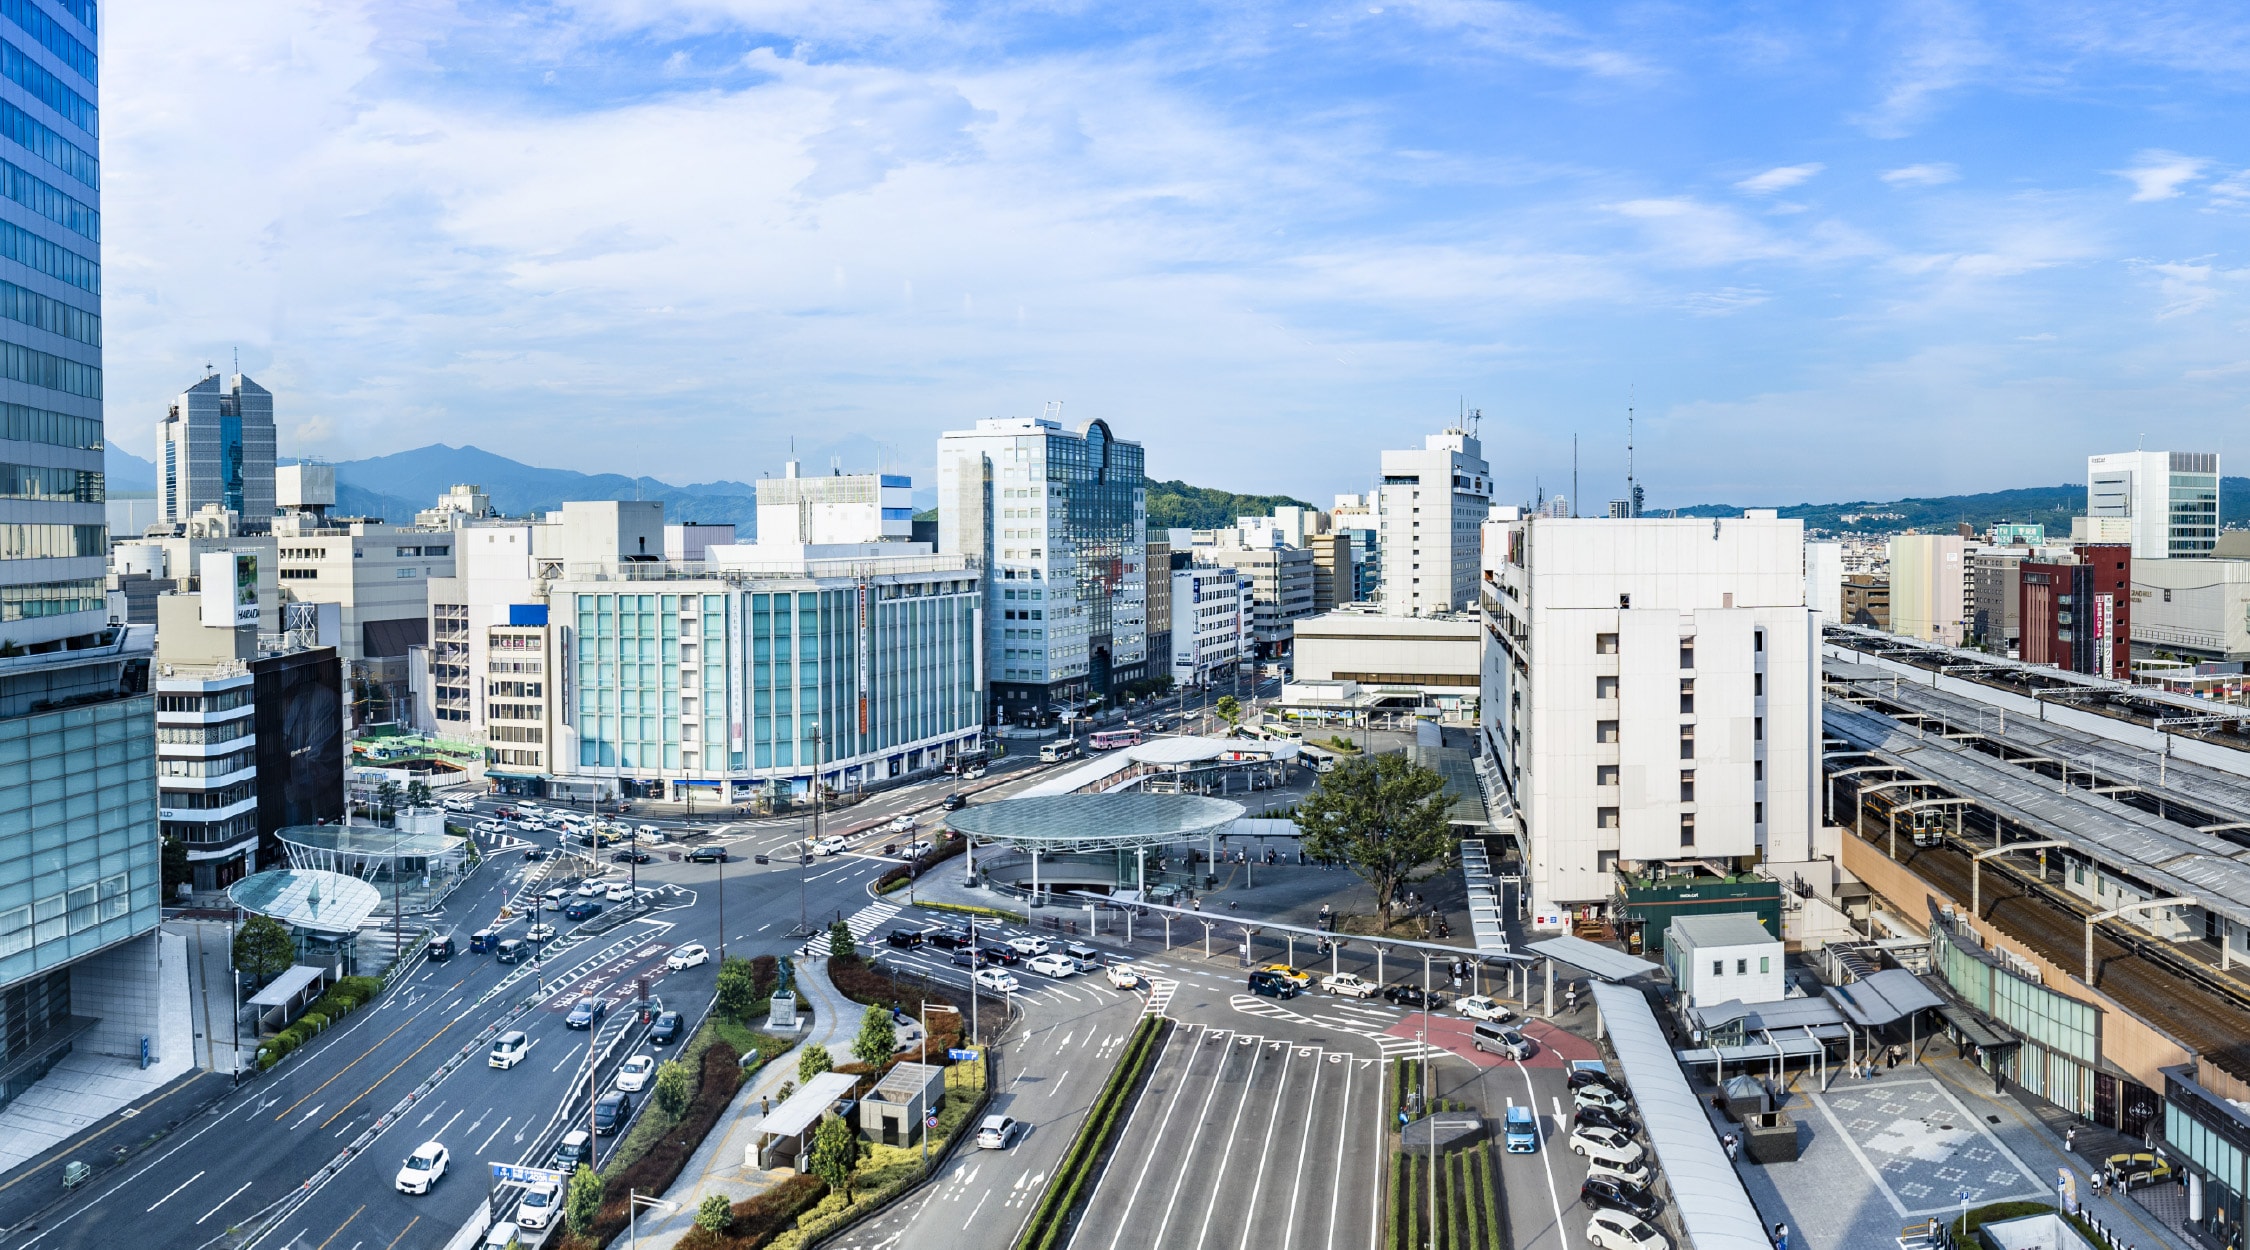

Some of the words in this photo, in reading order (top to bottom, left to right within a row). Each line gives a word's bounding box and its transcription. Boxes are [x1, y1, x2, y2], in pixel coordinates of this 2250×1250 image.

[1211, 1031, 1224, 1039] 2
[1239, 1037, 1253, 1045] 3
[1269, 1042, 1281, 1051] 4
[1298, 1048, 1312, 1057] 5
[1329, 1054, 1342, 1063] 6
[1360, 1061, 1373, 1069] 7
